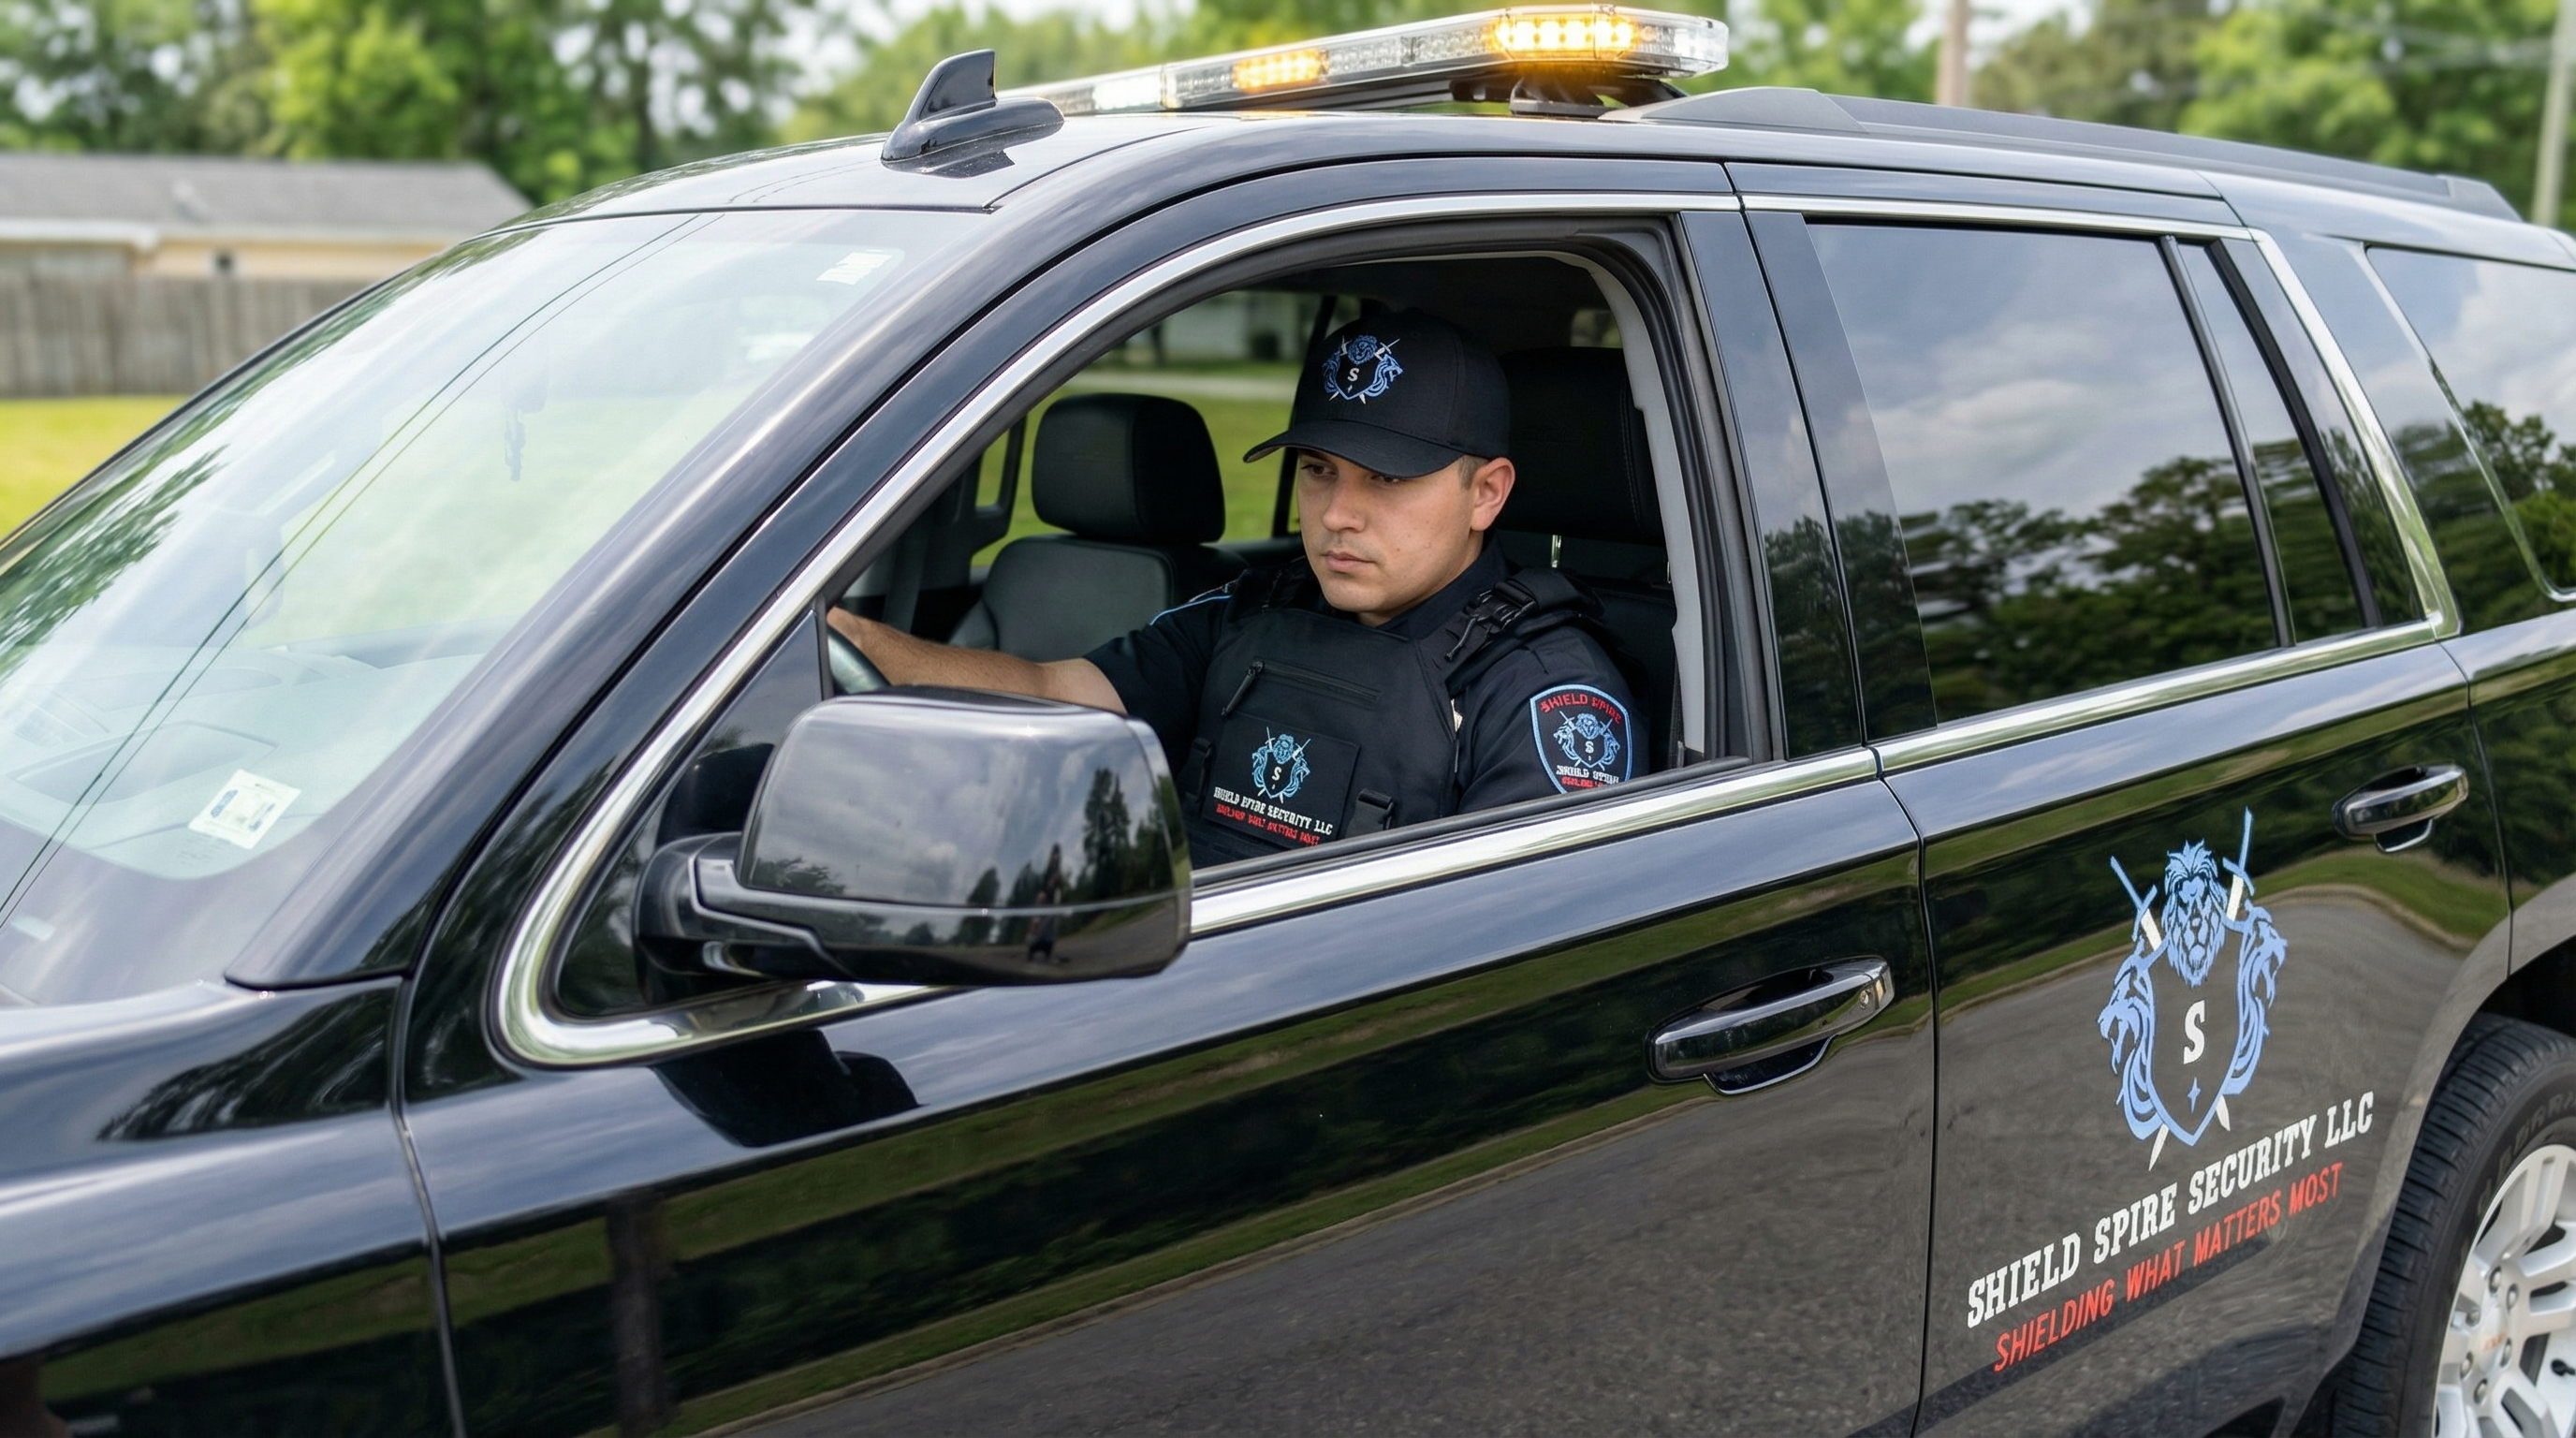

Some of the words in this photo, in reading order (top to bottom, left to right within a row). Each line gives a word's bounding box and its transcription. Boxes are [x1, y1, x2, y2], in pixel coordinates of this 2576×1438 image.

[1347, 367, 1360, 382] S
[1271, 766, 1282, 781] S
[1313, 819, 1334, 836] LLC
[2183, 999, 2205, 1064] S
[1967, 1232, 2081, 1328] SHIELD
[2093, 1181, 2178, 1265] SPIRE
[2188, 1114, 2318, 1215] SECURITY
[2324, 1091, 2374, 1149] LLC
[1994, 1279, 2115, 1372] SHIELDING
[2126, 1240, 2186, 1302] WHAT
[2193, 1190, 2281, 1267] MATTERS
[2289, 1162, 2343, 1217] MOST
